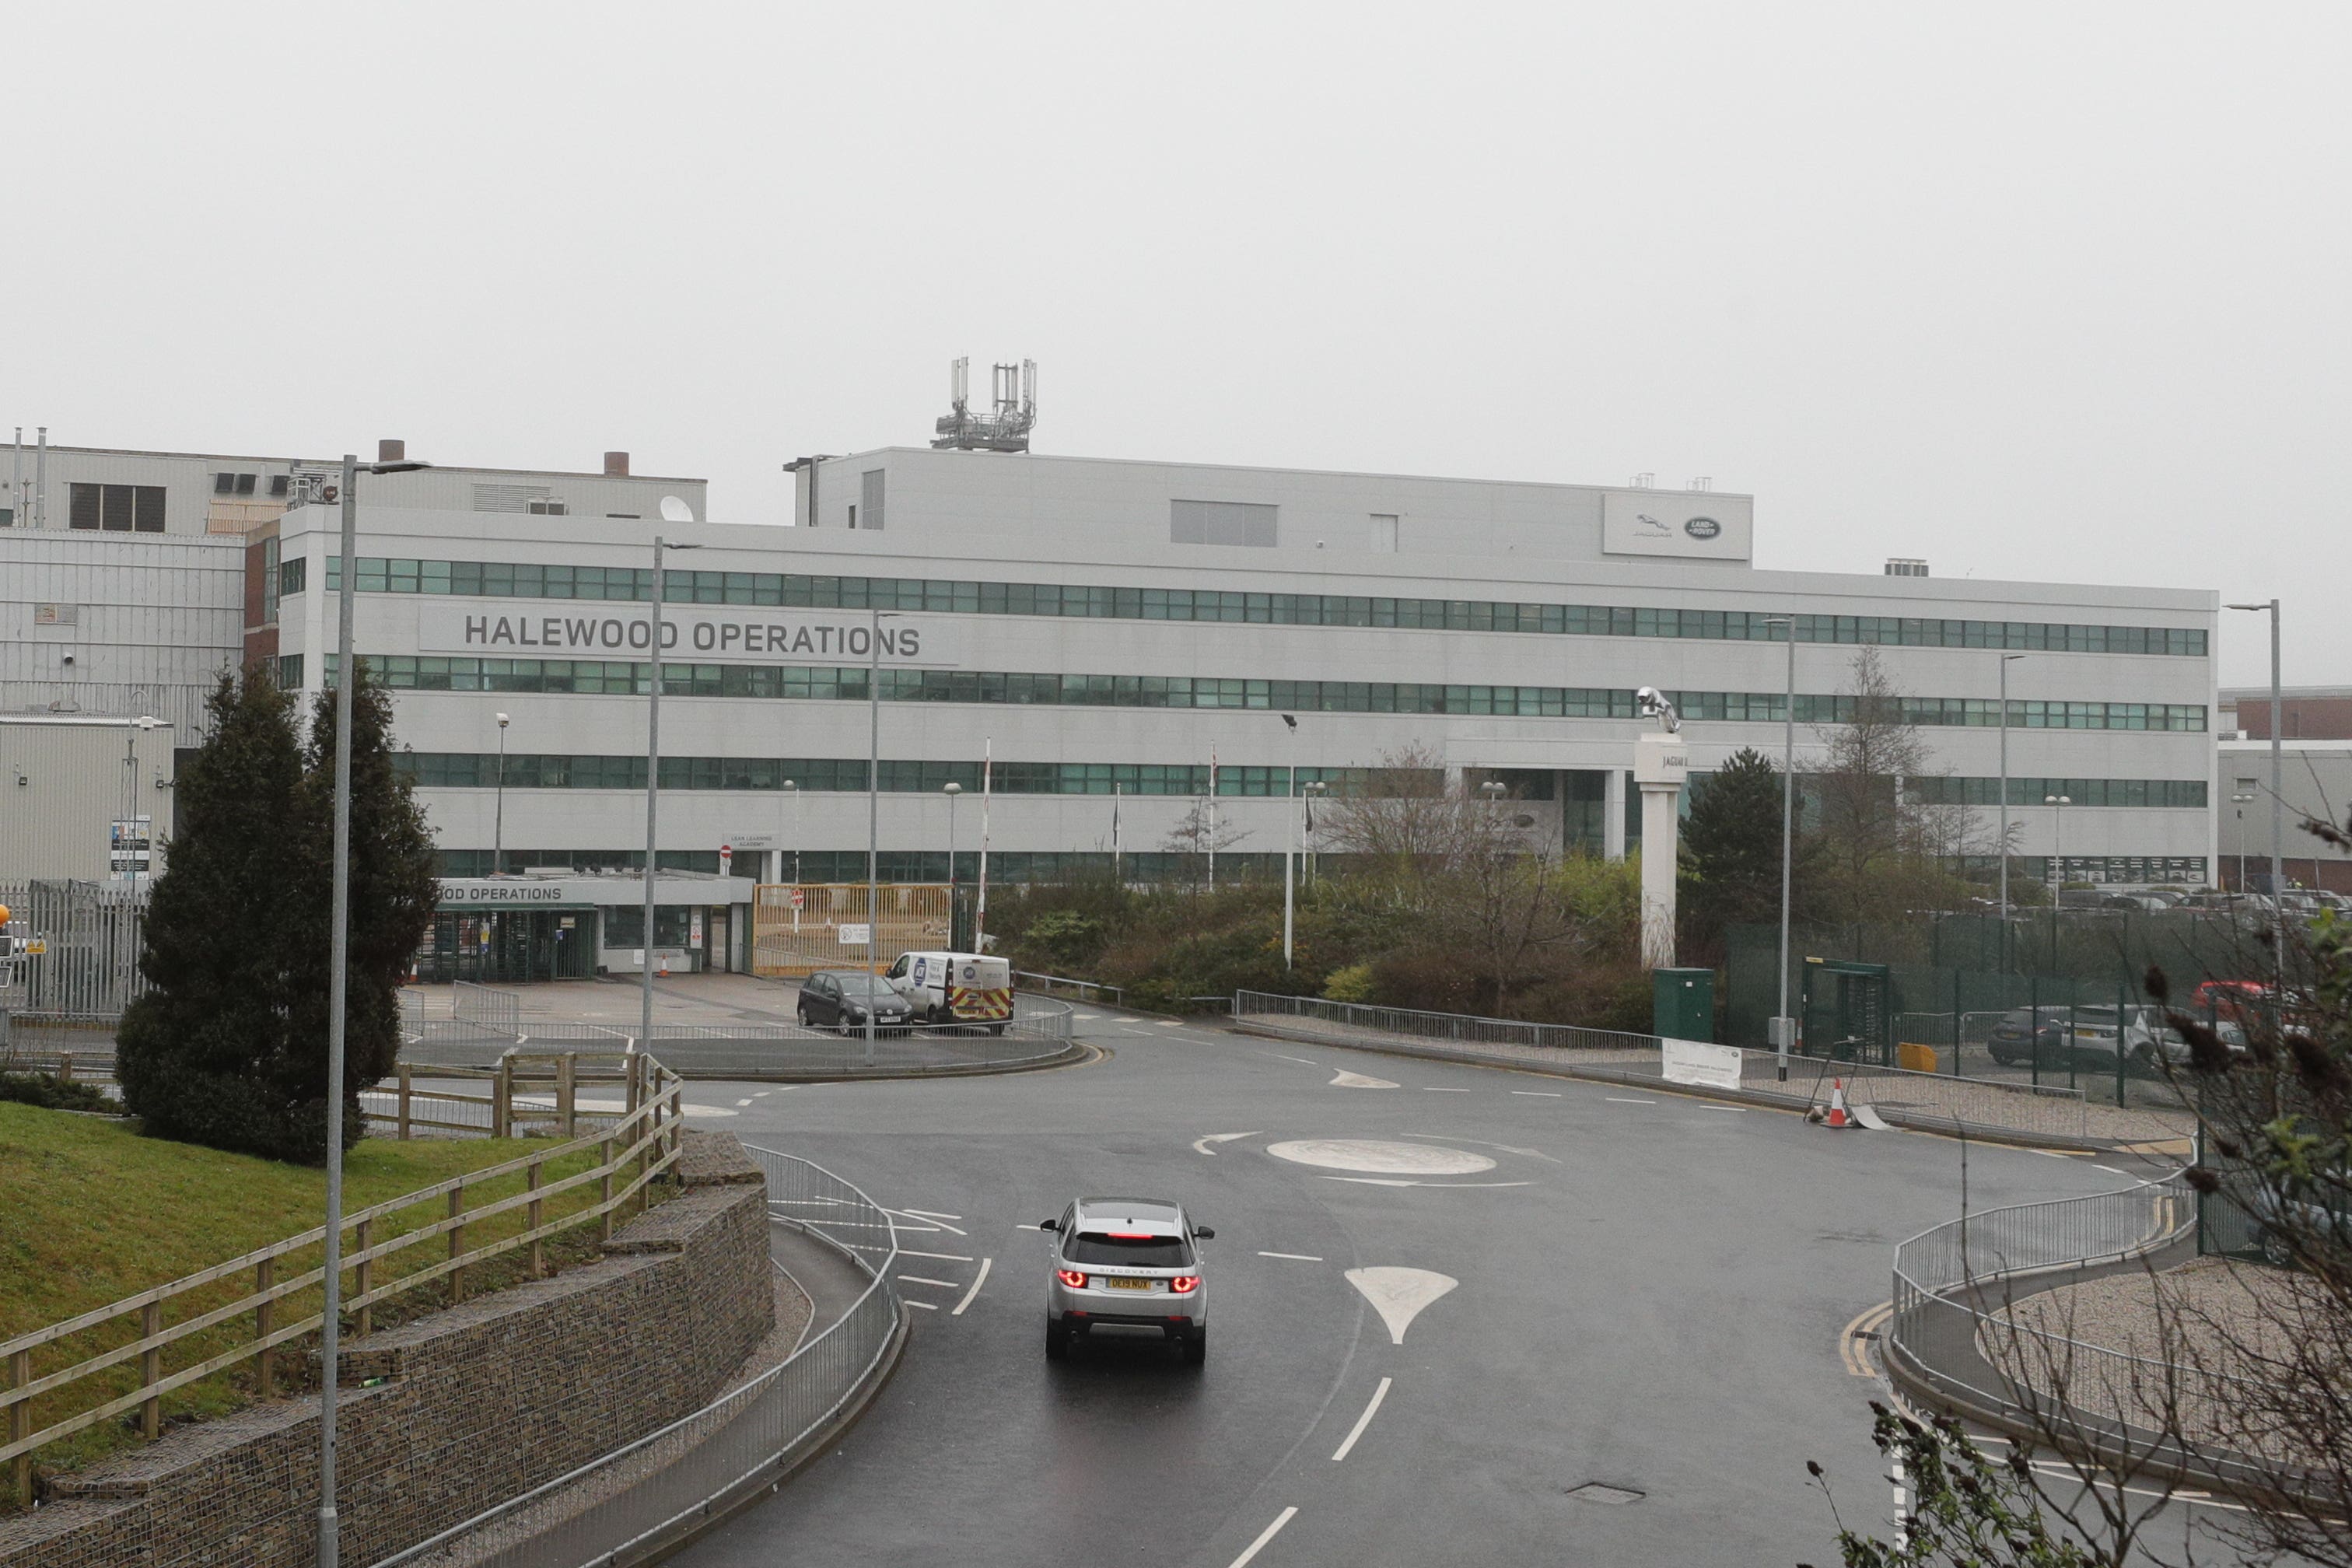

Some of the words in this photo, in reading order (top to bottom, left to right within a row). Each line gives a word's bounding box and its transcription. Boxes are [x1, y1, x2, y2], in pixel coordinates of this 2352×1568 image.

[466, 615, 678, 649] HALEWOOD
[693, 621, 920, 656] OPERATIONS
[470, 887, 562, 900] OPERATIONS
